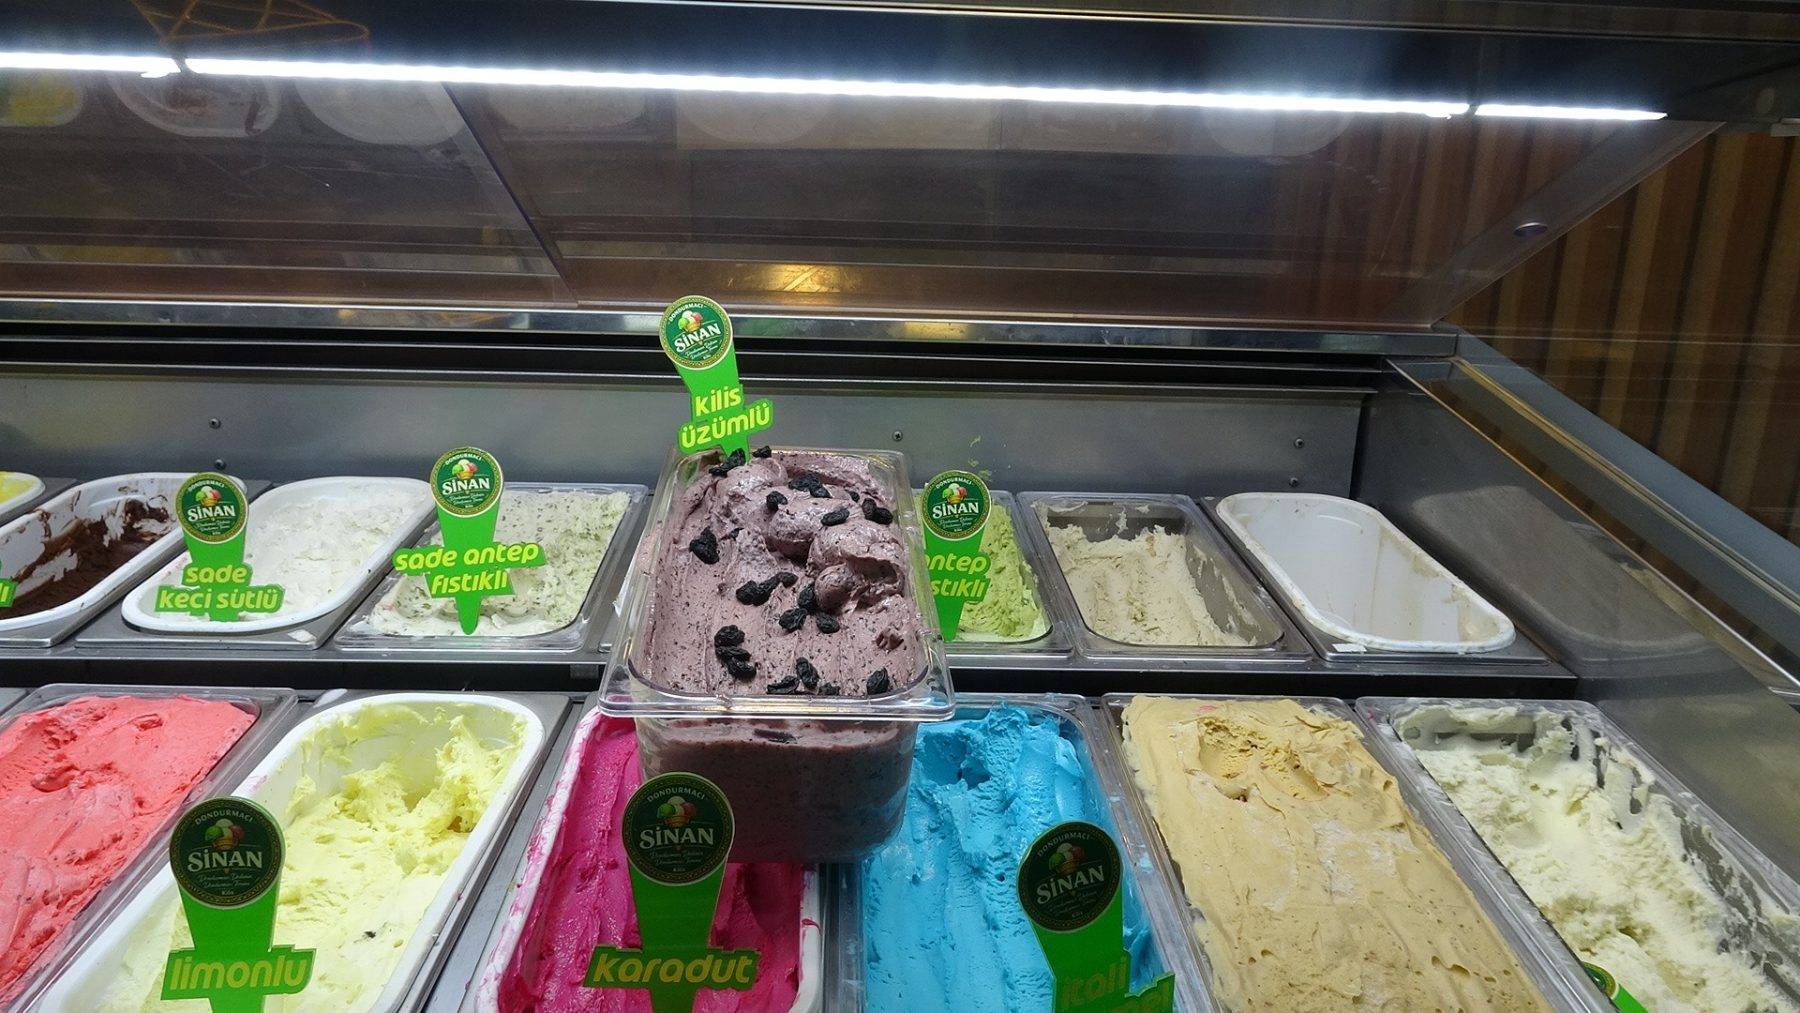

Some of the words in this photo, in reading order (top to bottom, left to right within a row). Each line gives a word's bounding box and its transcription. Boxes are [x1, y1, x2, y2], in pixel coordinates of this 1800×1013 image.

[674, 322, 722, 353] SİNAN
[695, 386, 742, 417] kilis
[681, 403, 770, 448] üzümlü
[442, 478, 490, 495] SİNAN
[187, 505, 236, 522] SİNAN
[932, 501, 979, 519] SİNAN
[395, 548, 457, 571] sade
[463, 542, 539, 565] antep
[186, 564, 248, 583] sade
[431, 570, 508, 594] fıstıklı
[647, 786, 706, 802] DONDURMACI
[194, 810, 254, 826] DONDURMACI
[639, 826, 714, 849] SİNAN
[187, 849, 263, 873] SİNAN
[1036, 864, 1105, 905] SİNAN
[170, 955, 307, 991] limonlu
[593, 953, 753, 984] karadut
